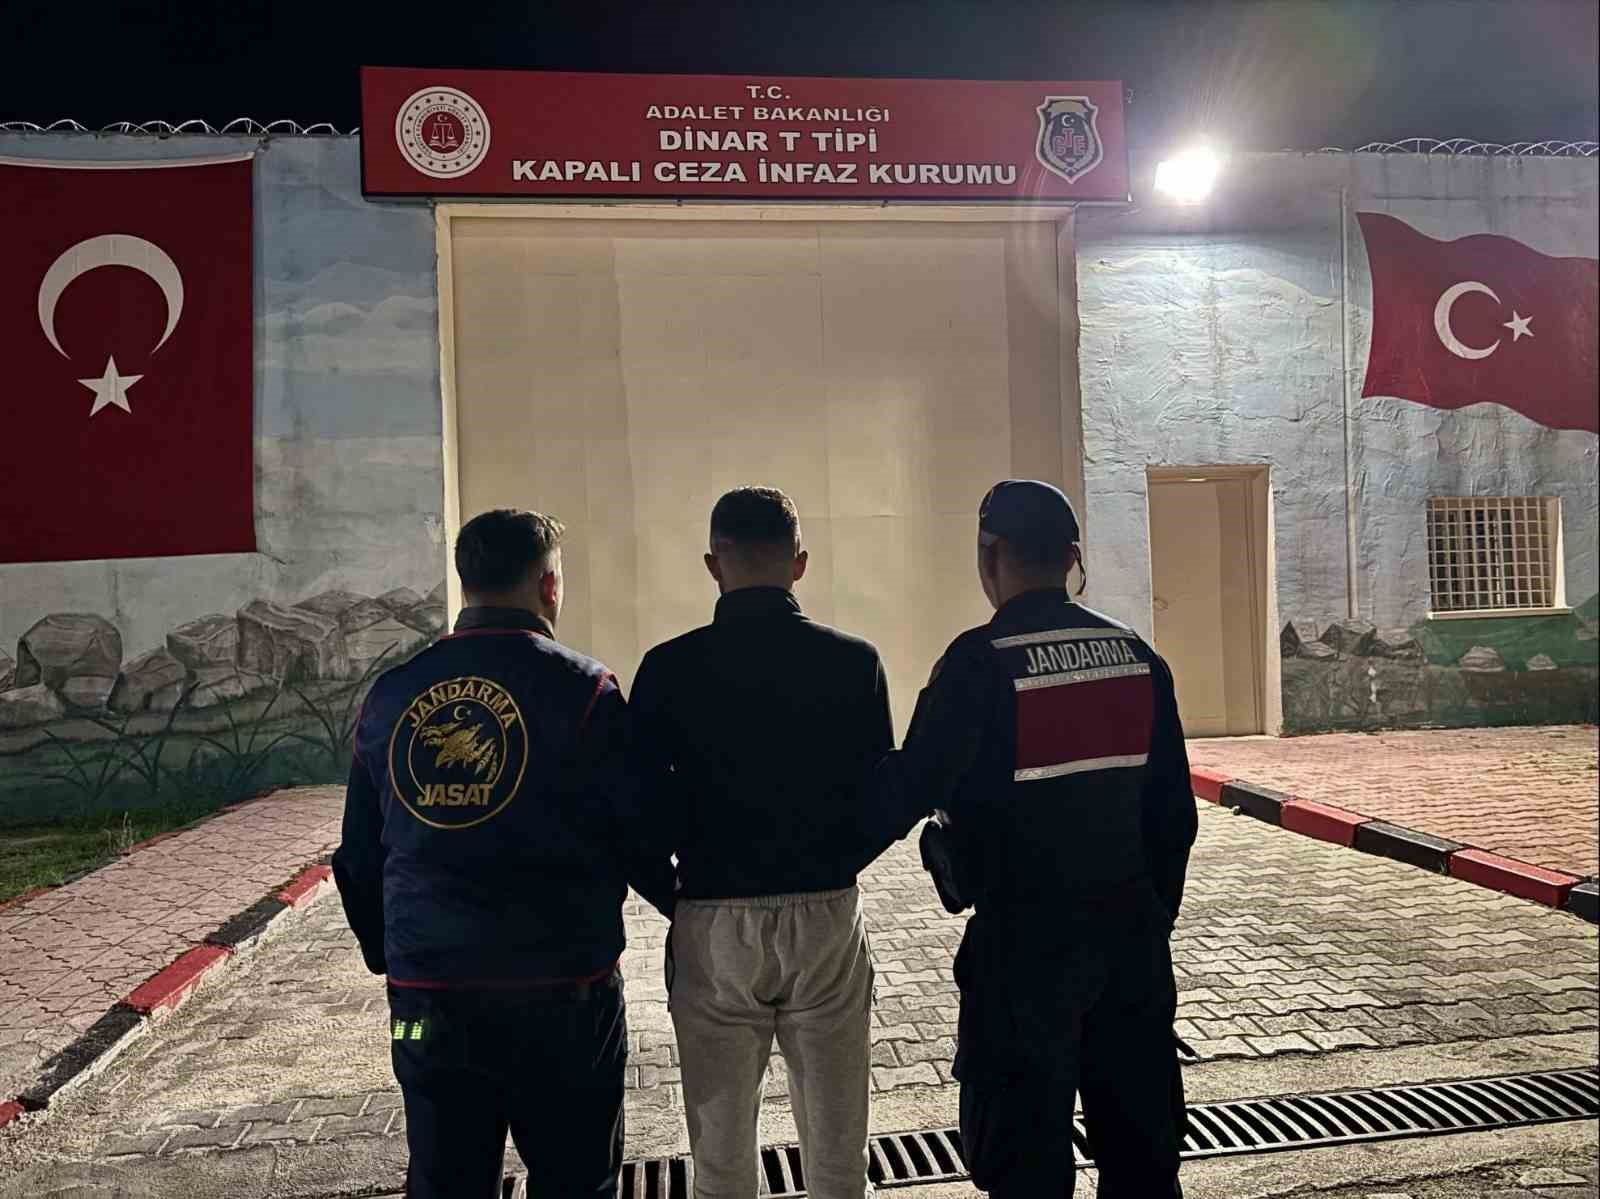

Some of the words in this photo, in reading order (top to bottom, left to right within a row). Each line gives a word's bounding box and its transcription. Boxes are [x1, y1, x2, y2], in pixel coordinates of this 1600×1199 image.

[746, 85, 791, 100] T.C.
[646, 105, 744, 120] ADALET
[753, 106, 890, 122] BAKANLIĞI
[659, 127, 768, 151] DİNAR
[779, 131, 800, 152] T
[812, 128, 878, 153] TİPİ
[512, 160, 641, 182] KAPALI
[654, 162, 747, 183] CEZA
[759, 158, 858, 184] İNFAZ
[870, 165, 1017, 184] KURUMU
[1026, 639, 1136, 674] JANDARMA
[407, 681, 517, 729] JANDARMA
[416, 783, 493, 806] JASAT
